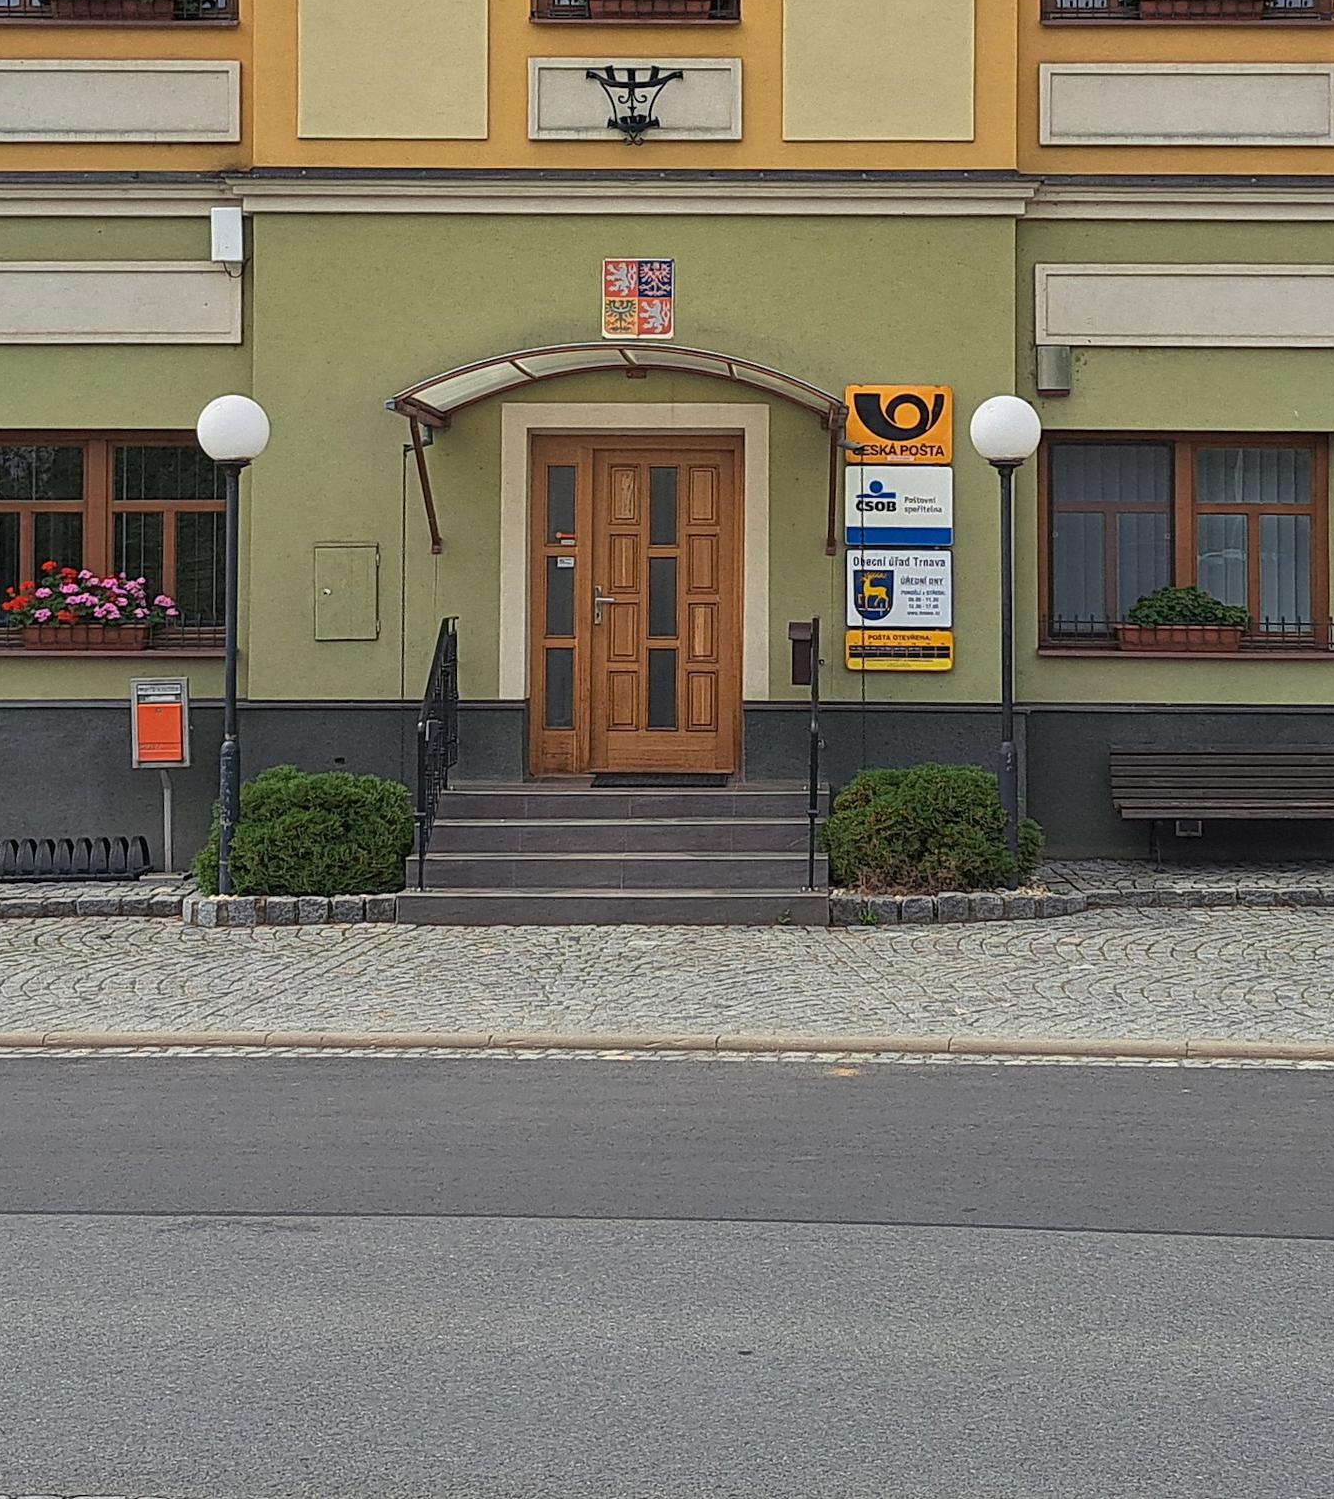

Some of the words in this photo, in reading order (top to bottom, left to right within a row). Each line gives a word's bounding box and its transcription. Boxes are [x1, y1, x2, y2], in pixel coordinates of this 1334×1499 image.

[900, 443, 945, 456] POŠTA
[904, 496, 937, 504] Poštovní
[855, 500, 897, 512] ČSOB
[904, 505, 942, 514] spořitelna
[888, 556, 910, 567] úřad
[913, 557, 946, 567] Trnava
